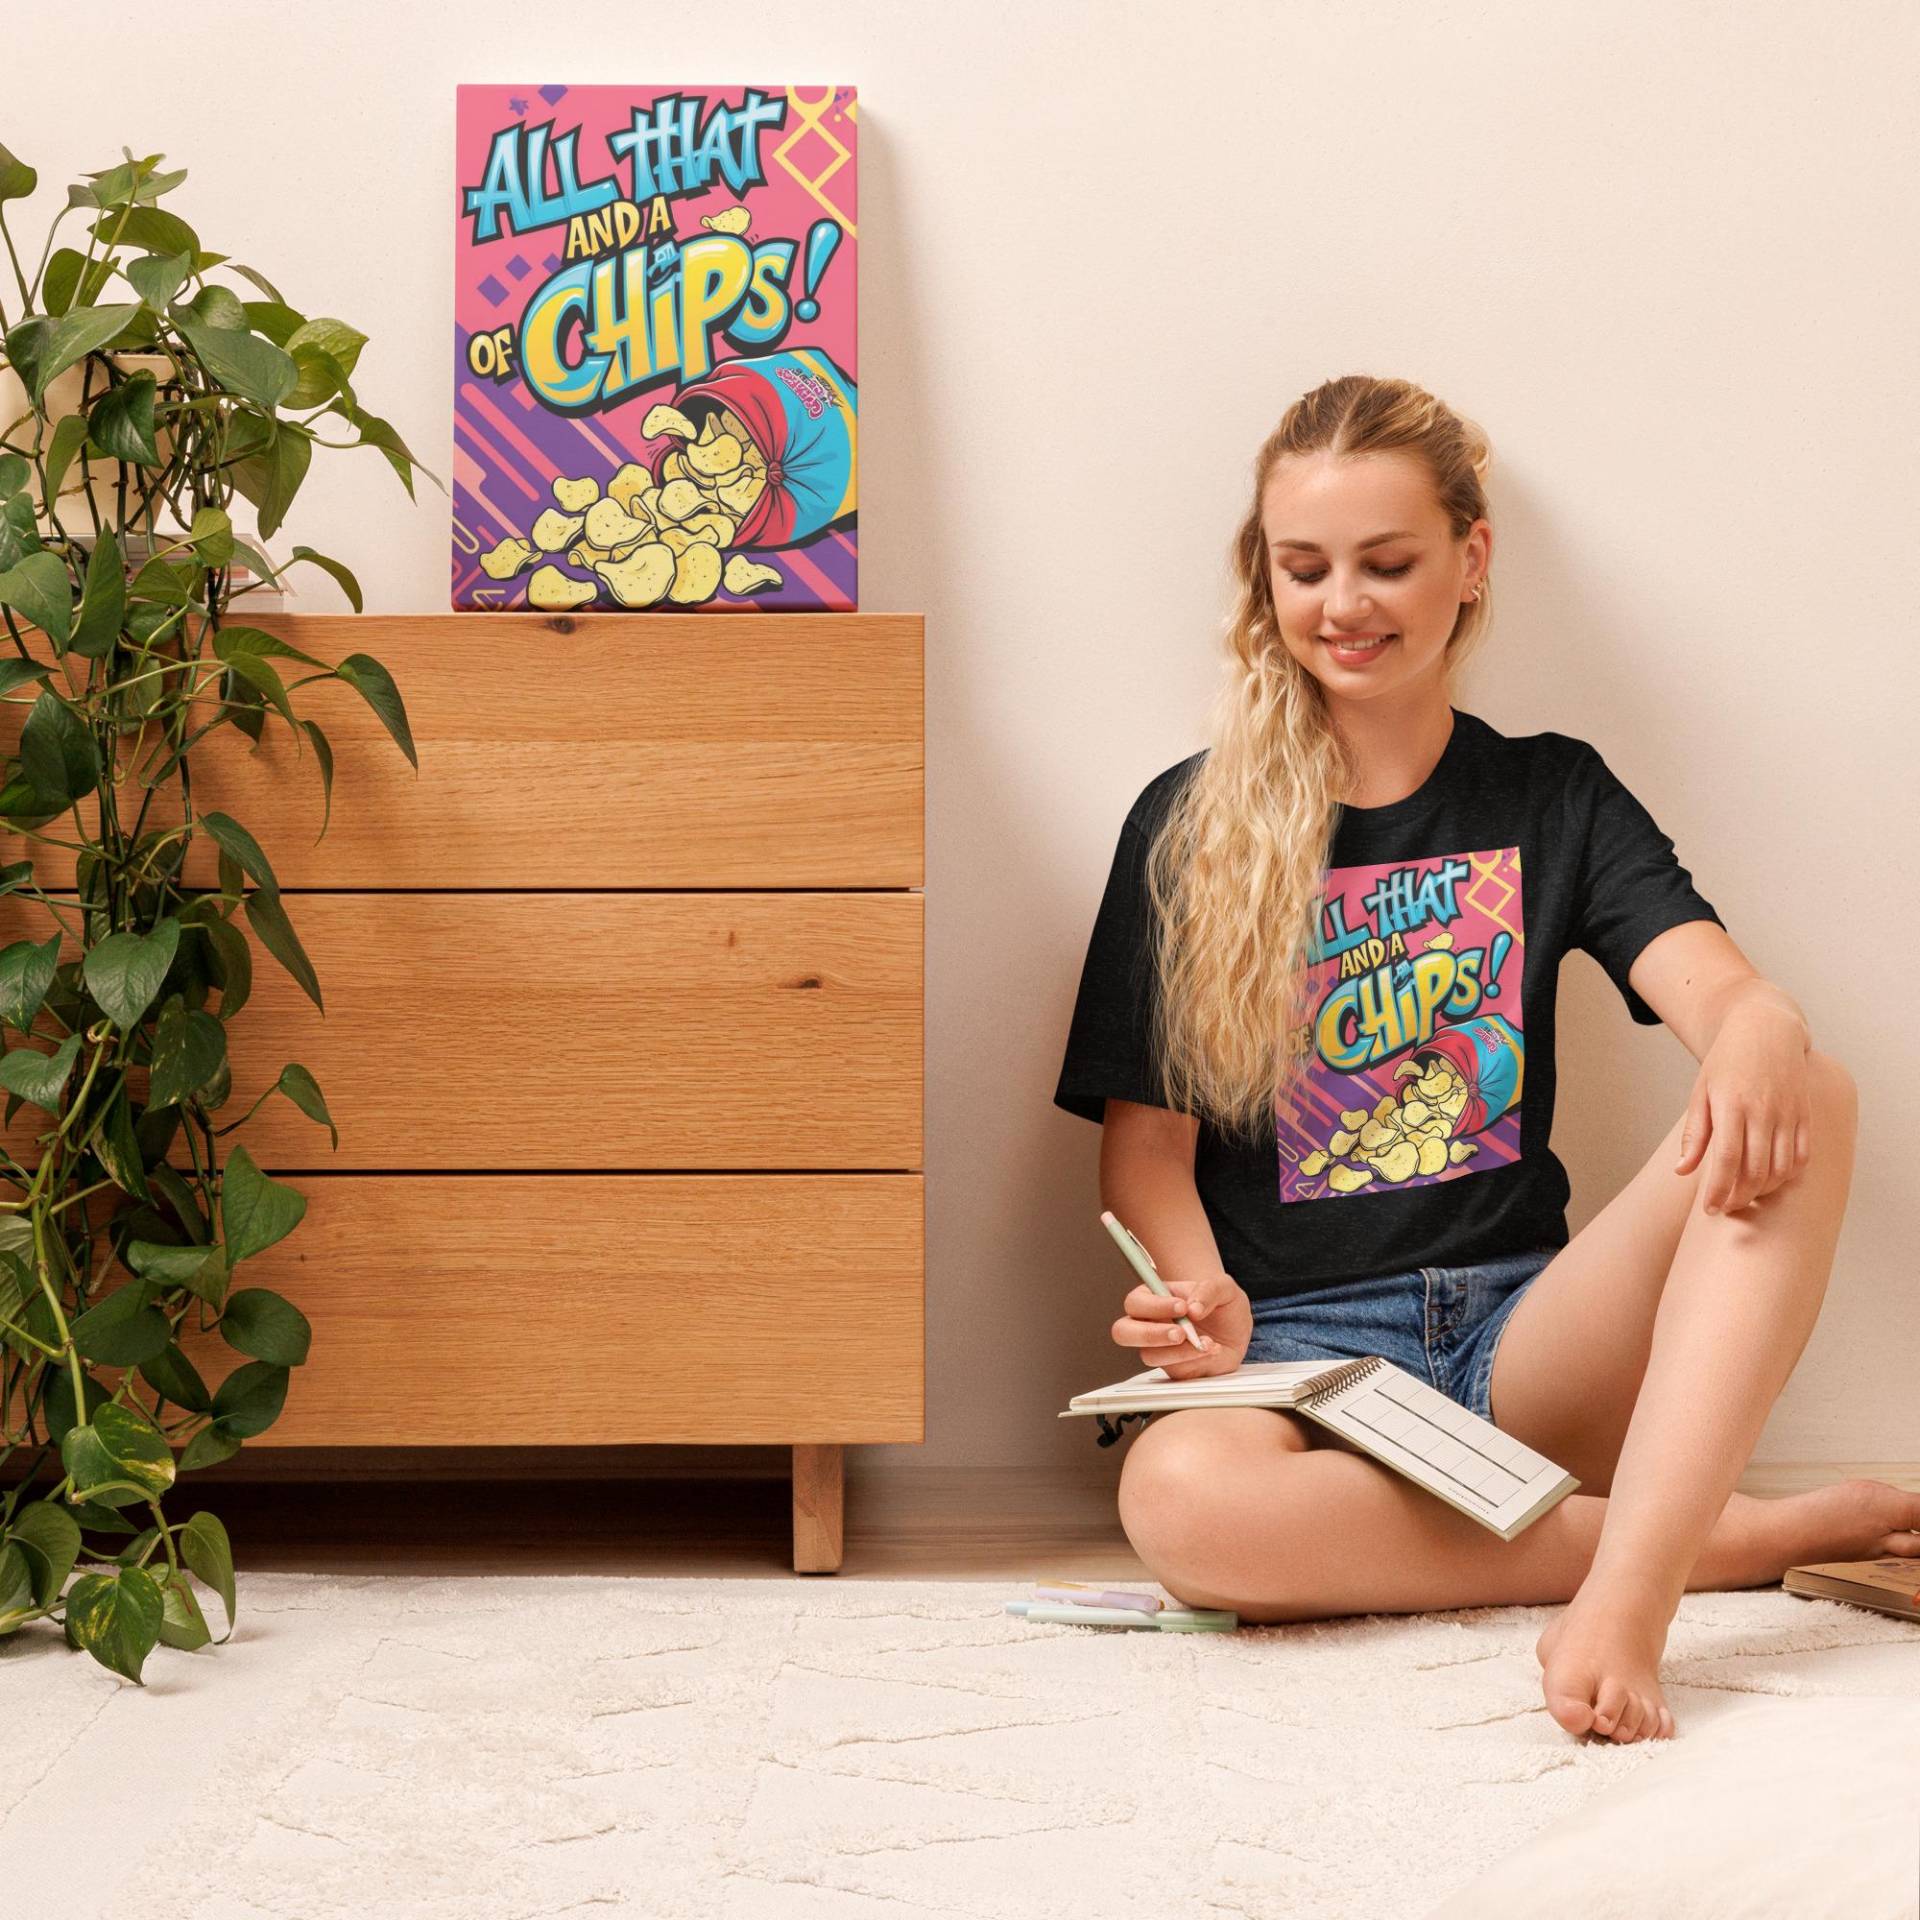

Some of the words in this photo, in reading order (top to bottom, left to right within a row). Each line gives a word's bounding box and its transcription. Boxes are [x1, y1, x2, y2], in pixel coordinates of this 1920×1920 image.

[463, 121, 622, 244] ALL
[565, 200, 641, 260] AND
[648, 195, 673, 236] A
[469, 327, 513, 376] OF
[1307, 893, 1372, 967] LL
[1340, 938, 1385, 979] AND
[1390, 932, 1406, 957] A
